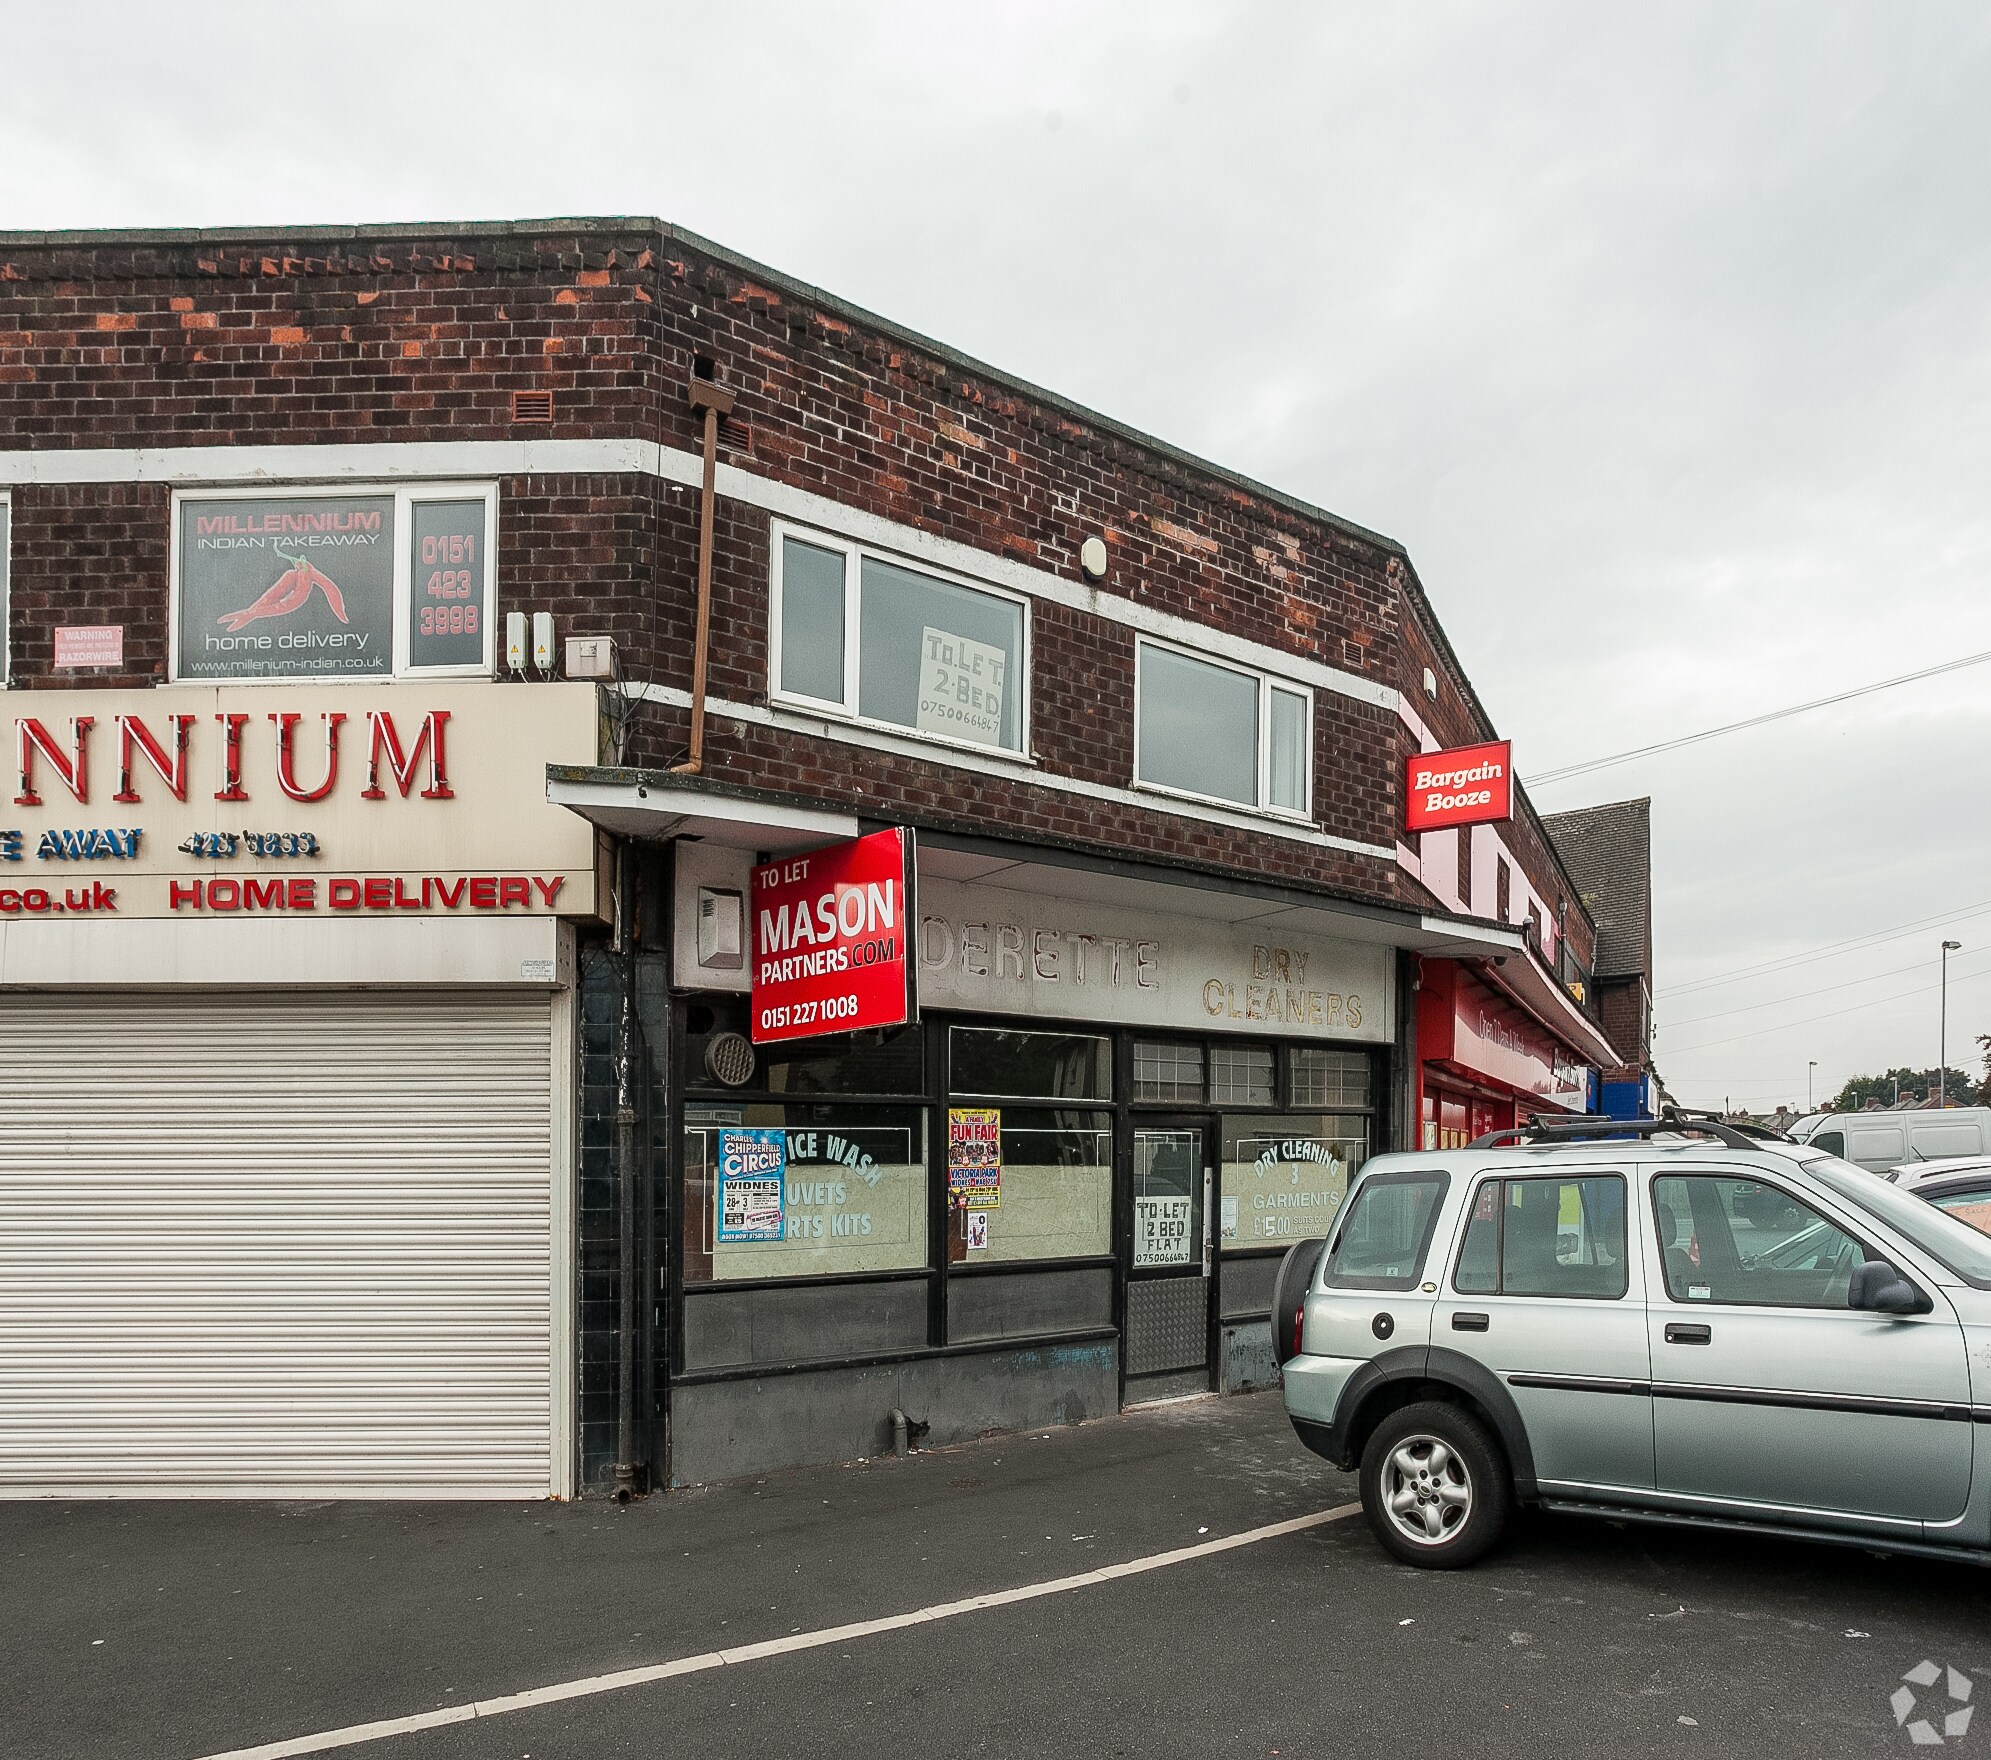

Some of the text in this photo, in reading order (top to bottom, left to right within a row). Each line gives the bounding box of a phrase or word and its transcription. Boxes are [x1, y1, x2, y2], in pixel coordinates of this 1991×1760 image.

[196, 511, 381, 535] MILLENNIUM
[197, 533, 381, 550] INDIAN TAKEAWAY
[422, 534, 475, 565] 0151
[427, 569, 472, 599] 423
[420, 605, 478, 636] 3998
[63, 630, 112, 641] WARNING
[205, 630, 369, 651] home delivery
[59, 651, 119, 663] RAZORWIRE
[13, 710, 455, 804] NNIUM
[1414, 760, 1503, 791] Bargain
[1424, 789, 1492, 813] Booze
[35, 828, 143, 860] AWAY
[177, 831, 240, 858] 423
[760, 859, 810, 889] TO LET
[0, 875, 566, 911] co.uk HOME DELIVERY
[760, 878, 894, 955] MASON
[1252, 944, 1310, 985] DRY
[761, 994, 858, 1029] 0151 227 1008
[1202, 978, 1363, 1029] CLEANERS
[723, 1133, 753, 1143] CHARLES
[950, 1124, 998, 1141] FUN FAIR
[724, 1142, 781, 1155] CHIPPERFIELD
[1253, 1140, 1340, 1179] DRY CLEANING
[724, 1152, 781, 1177] CIRCUS
[826, 1134, 884, 1189] WASH
[950, 1167, 998, 1179] VICTORIA PARK
[1290, 1162, 1299, 1185] 3
[725, 1181, 779, 1190] WIDNES
[784, 1182, 848, 1206] UVETS
[950, 1178, 971, 1187] WIDNES
[726, 1197, 736, 1208] 28
[742, 1197, 748, 1208] 3
[1252, 1191, 1340, 1210] GARMENTS
[830, 1212, 872, 1238] KITS
[1147, 1220, 1185, 1237] 2 BED
[1304, 1226, 1320, 1234] TWO
[1147, 1238, 1181, 1251] FLAT
